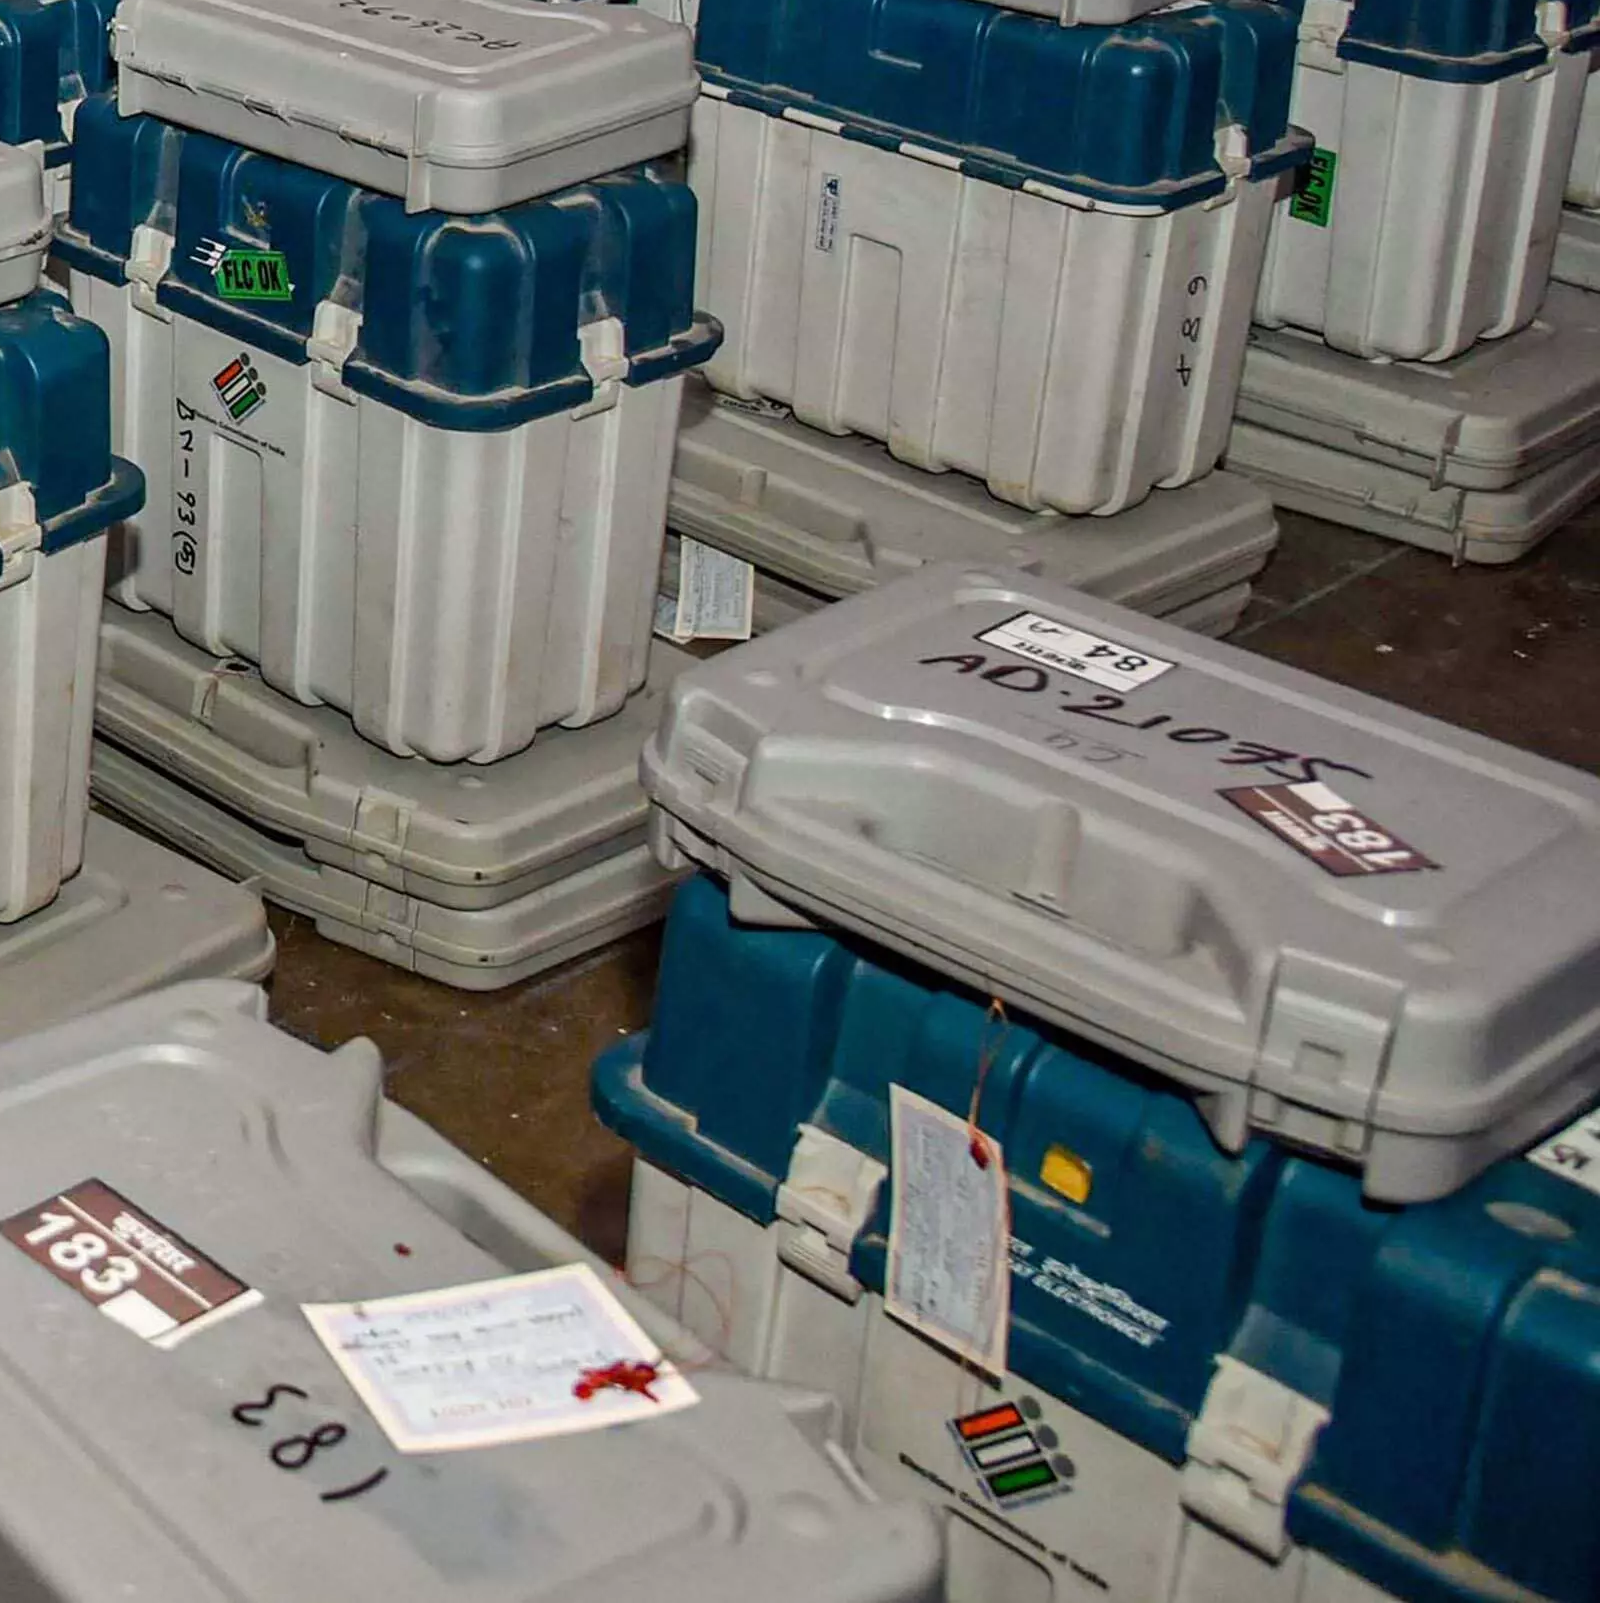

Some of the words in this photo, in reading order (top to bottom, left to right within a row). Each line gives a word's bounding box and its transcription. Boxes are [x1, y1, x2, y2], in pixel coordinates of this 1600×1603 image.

[221, 257, 254, 291] FLC
[256, 259, 284, 292] OK
[1084, 644, 1149, 672] 84
[1309, 808, 1412, 869] 183
[25, 1211, 140, 1295] 183
[230, 1383, 389, 1503] 183
